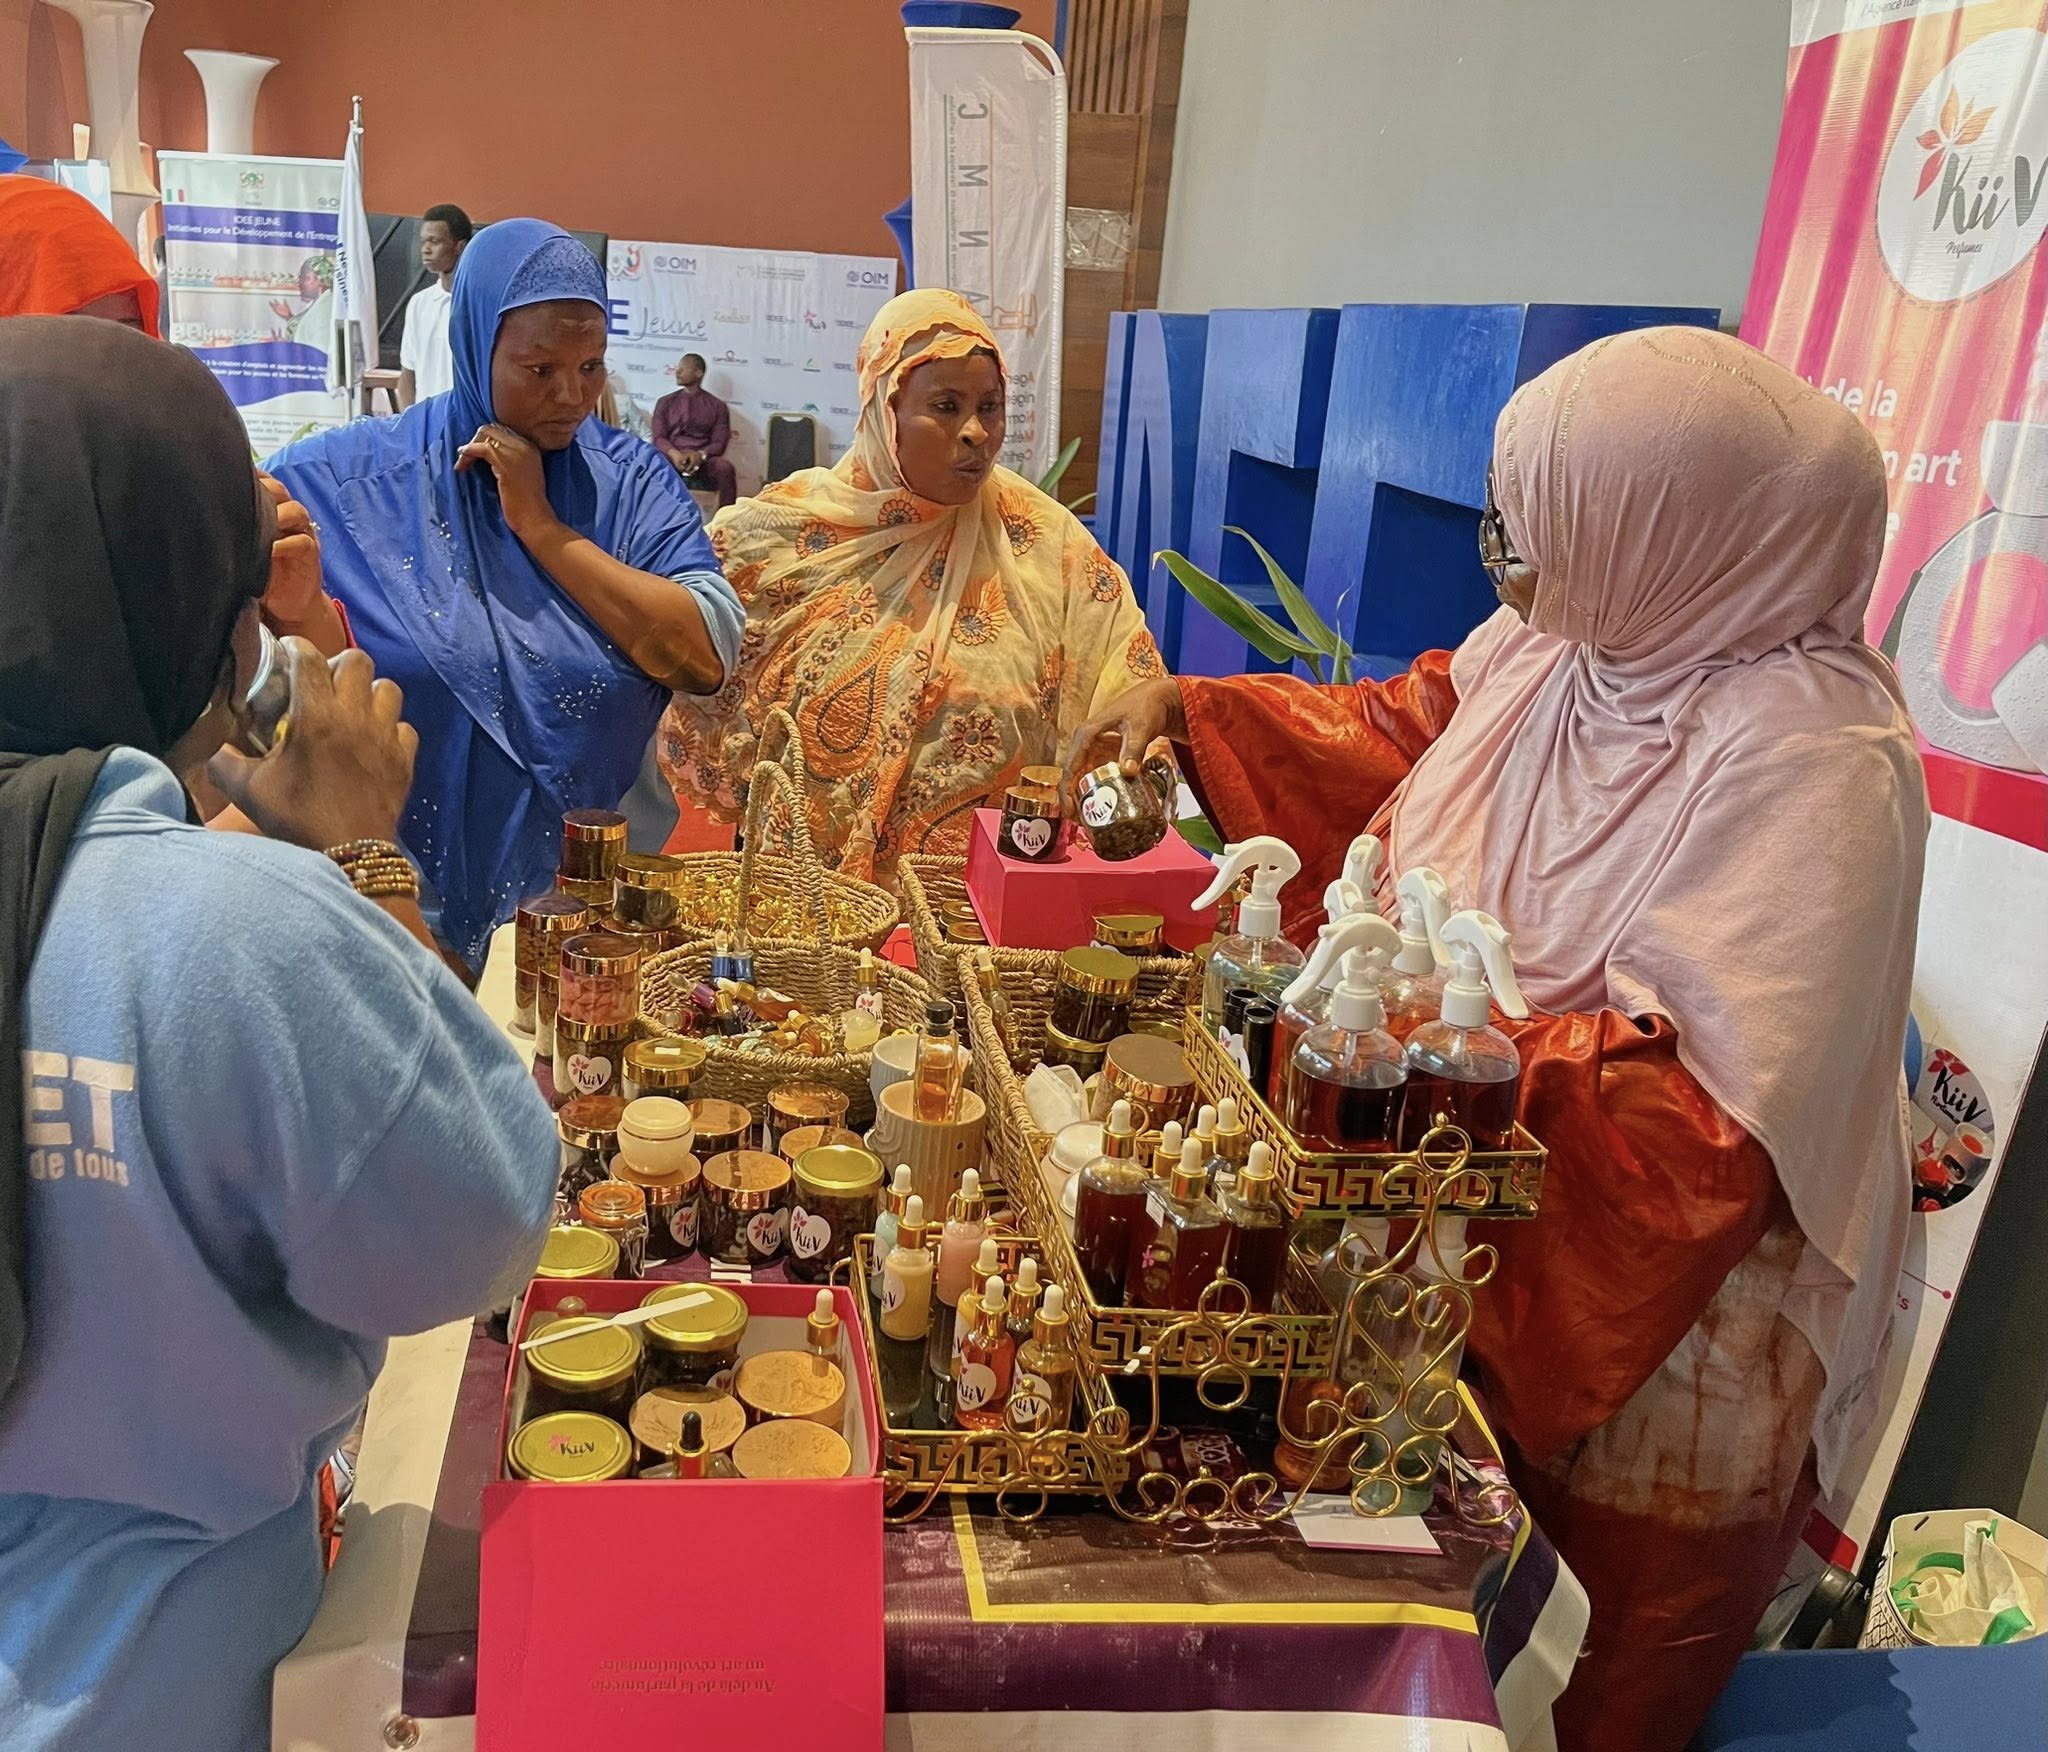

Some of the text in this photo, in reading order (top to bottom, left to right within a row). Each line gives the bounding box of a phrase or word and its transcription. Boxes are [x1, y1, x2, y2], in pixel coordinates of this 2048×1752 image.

[204, 227, 222, 236] pour
[296, 230, 304, 240] de
[669, 257, 696, 270] OIM
[862, 272, 888, 284] OIM
[623, 307, 706, 341] Jeune
[1869, 379, 1898, 417] la
[1904, 449, 1962, 486] art
[1023, 834, 1046, 847] KiiV
[578, 1070, 605, 1086] KiiV
[1933, 1065, 1988, 1123] KiiV
[30, 1149, 66, 1181] de
